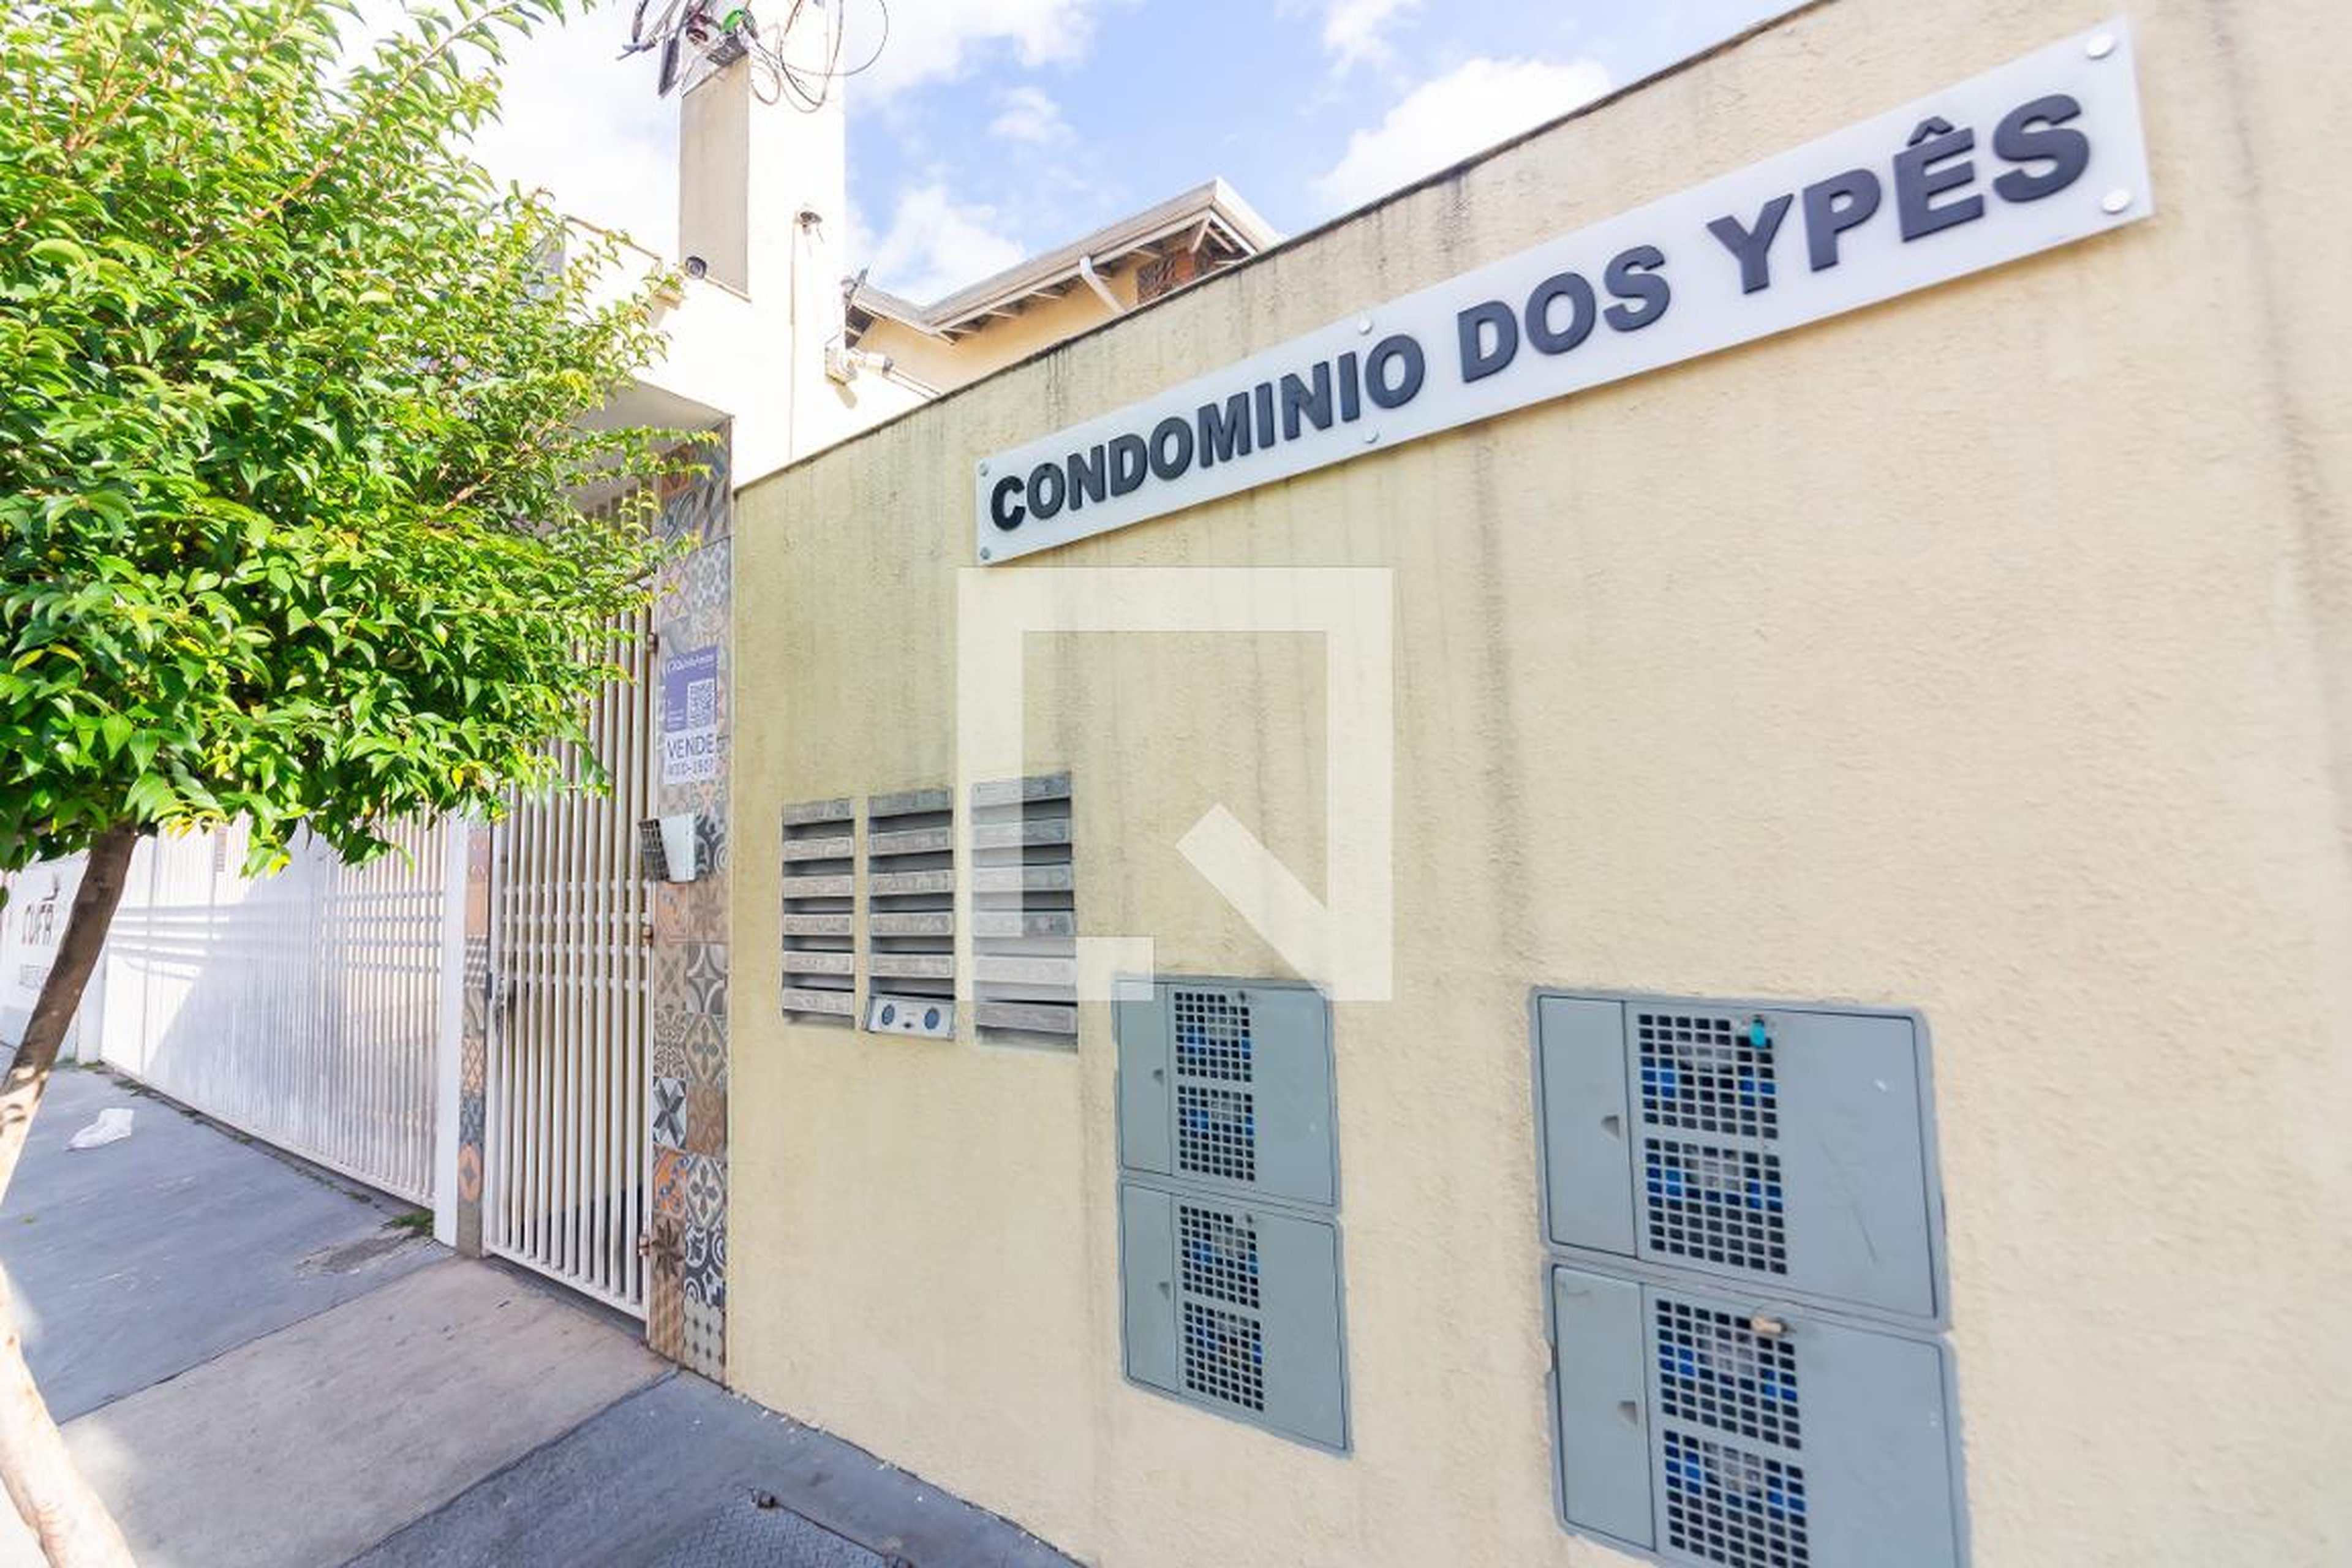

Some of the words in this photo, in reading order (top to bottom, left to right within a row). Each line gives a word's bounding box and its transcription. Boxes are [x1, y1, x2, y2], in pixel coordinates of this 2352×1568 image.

[990, 334, 1425, 532] CONDOMINIO
[1457, 244, 1671, 383] DOS
[1706, 92, 2090, 294] YPÊS
[667, 734, 714, 758] VENDE
